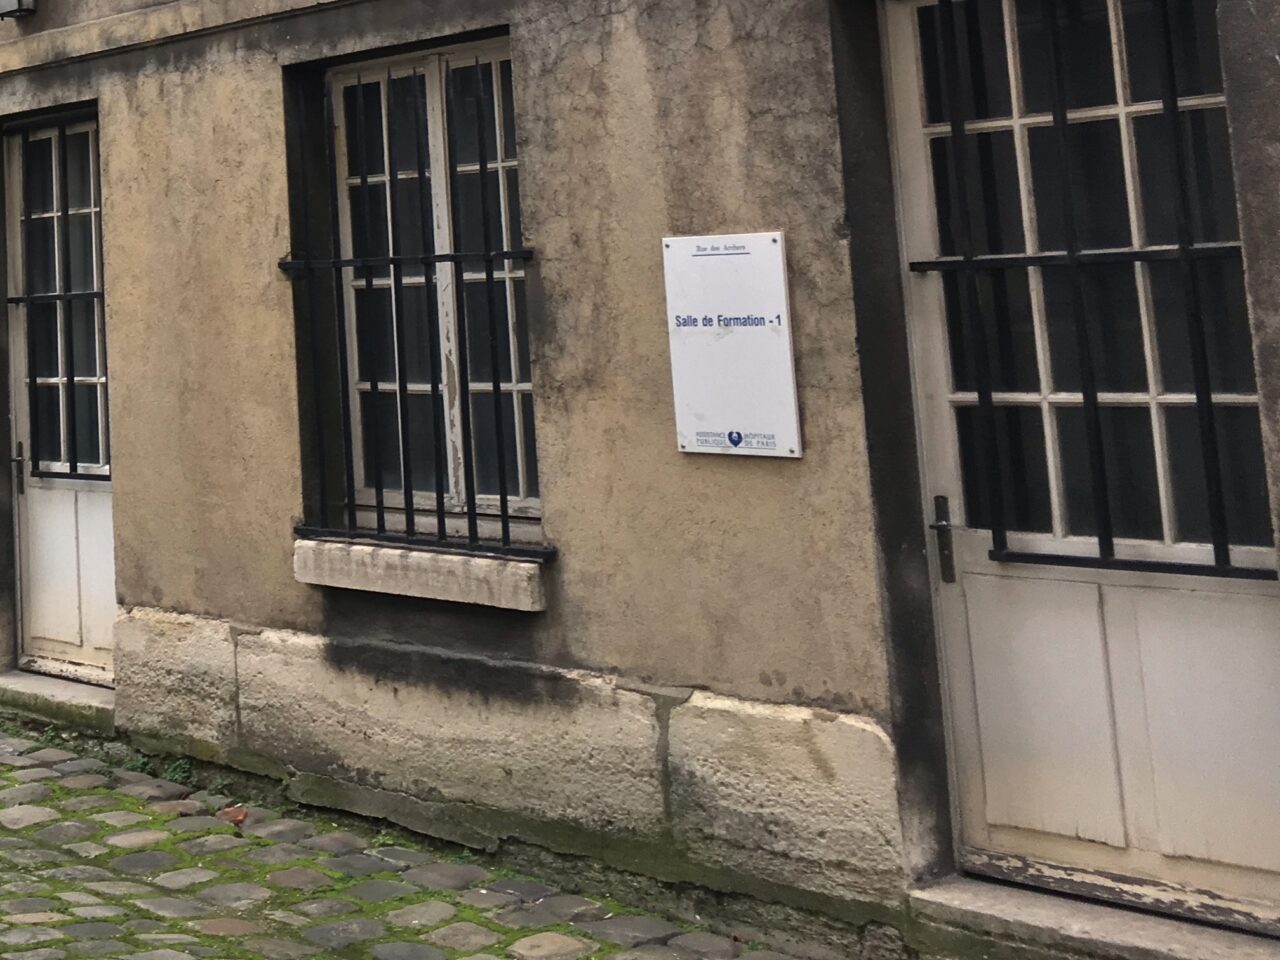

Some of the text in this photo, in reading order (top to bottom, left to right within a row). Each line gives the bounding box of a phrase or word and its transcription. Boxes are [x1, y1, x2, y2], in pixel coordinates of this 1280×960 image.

[675, 315, 698, 328] Salle
[702, 315, 713, 327] de
[717, 314, 766, 328] Formation
[776, 314, 782, 327] 1
